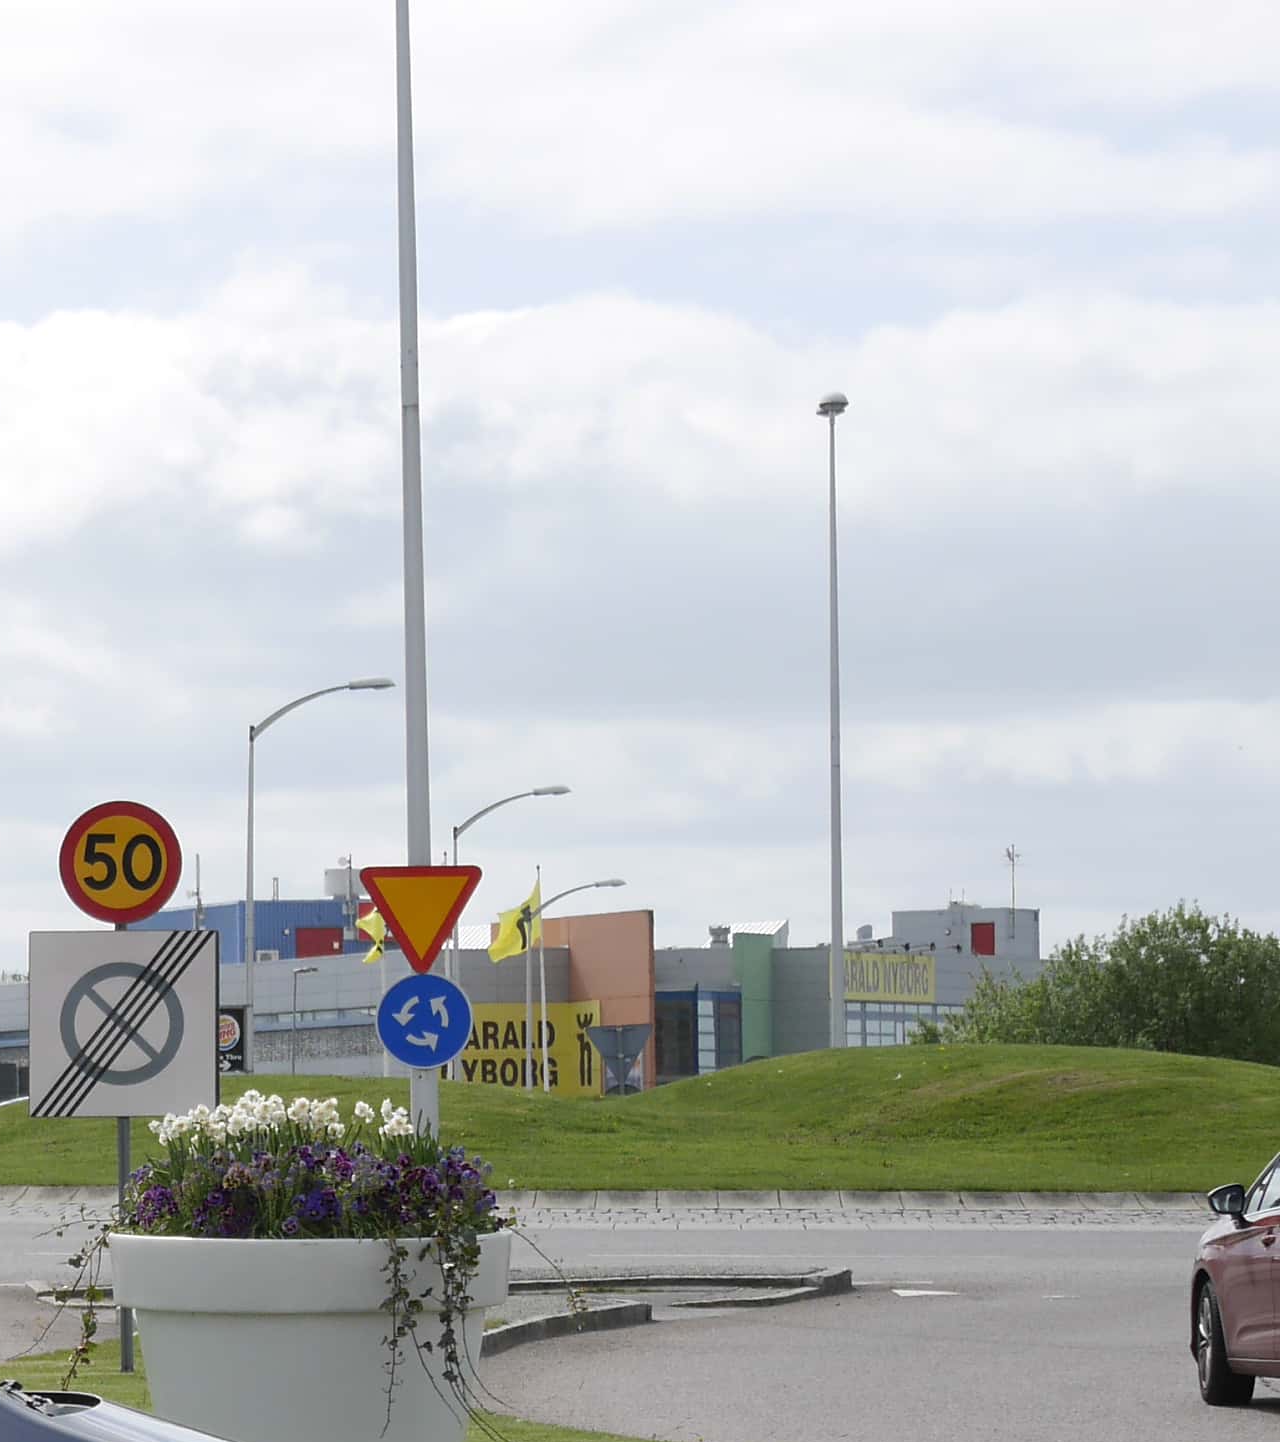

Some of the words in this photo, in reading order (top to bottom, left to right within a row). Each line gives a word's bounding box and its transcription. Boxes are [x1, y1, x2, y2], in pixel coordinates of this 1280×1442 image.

[84, 833, 162, 891] 50
[883, 960, 929, 996] NYBORG
[466, 1019, 556, 1050] ARALD
[441, 1057, 559, 1088] YBORG
